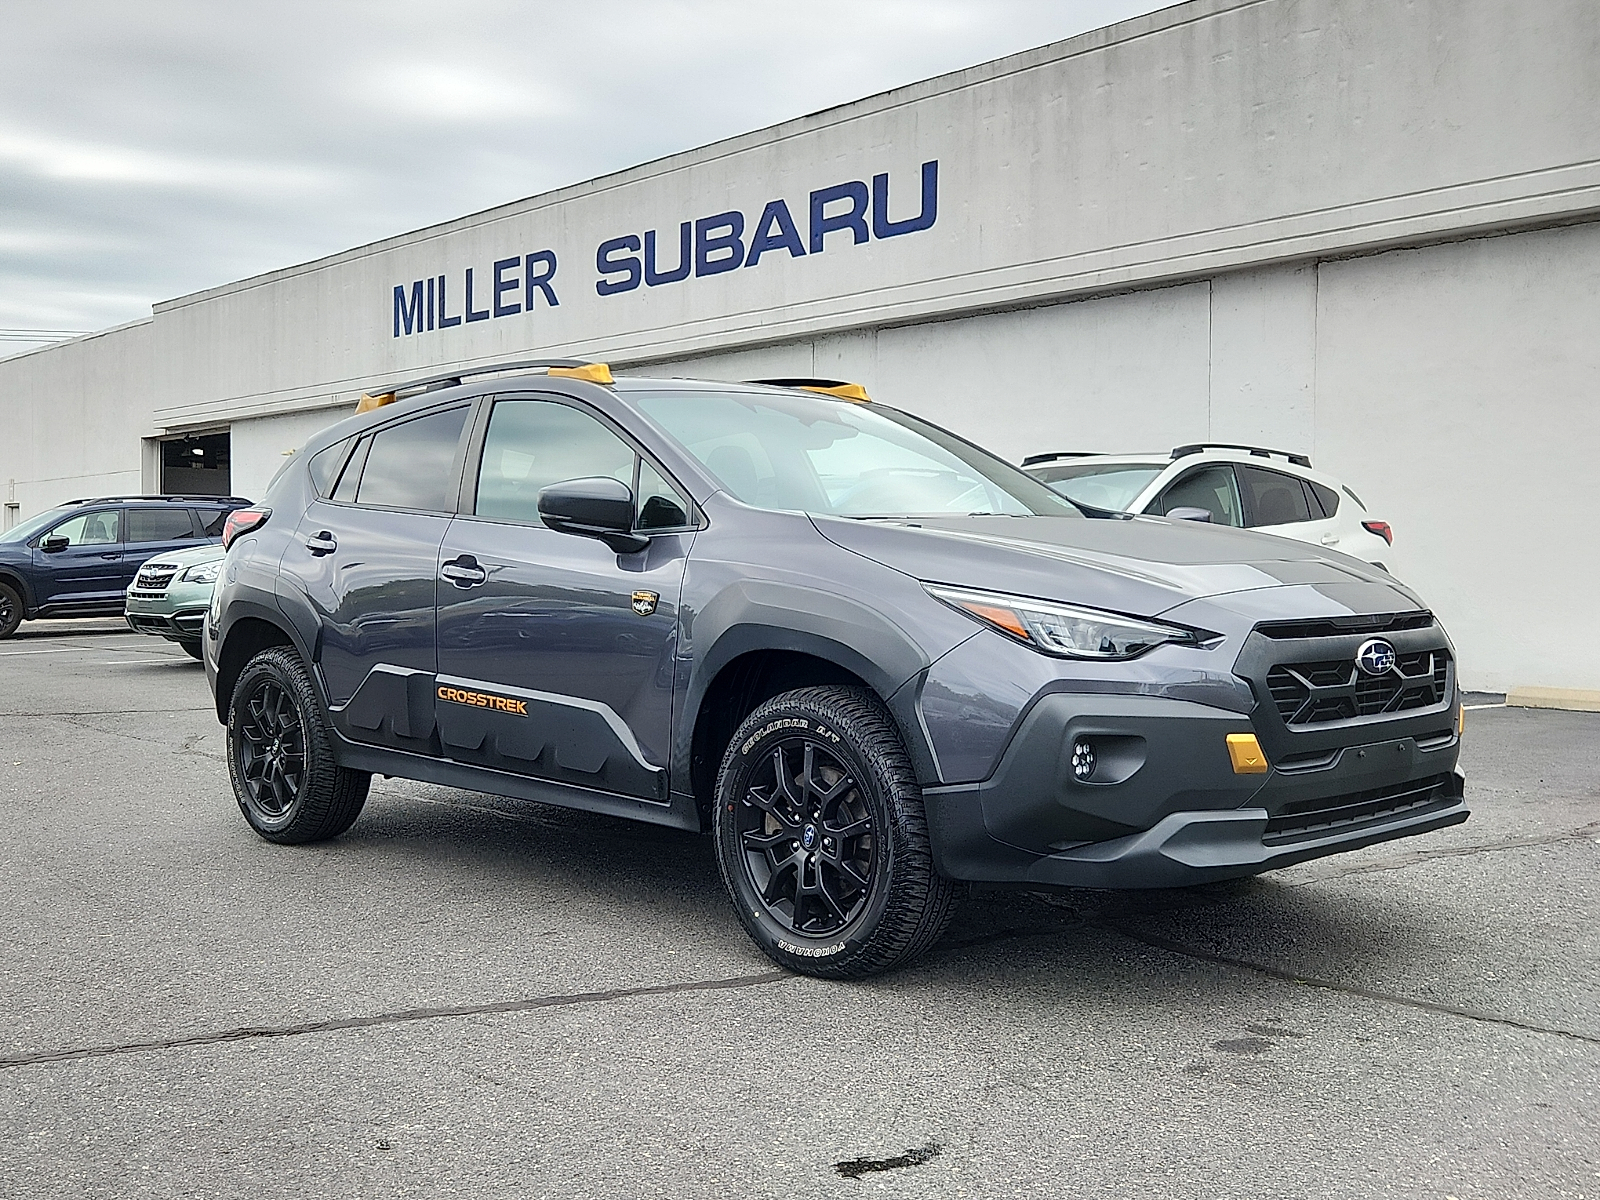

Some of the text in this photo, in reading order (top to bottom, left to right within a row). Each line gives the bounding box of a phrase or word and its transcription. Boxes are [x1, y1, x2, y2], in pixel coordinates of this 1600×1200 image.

[393, 159, 939, 338] MILLER SUBARU
[437, 686, 528, 715] CROSSTREK
[741, 718, 809, 755] GEOLANDAR
[777, 939, 846, 958] YOKOHAMA
